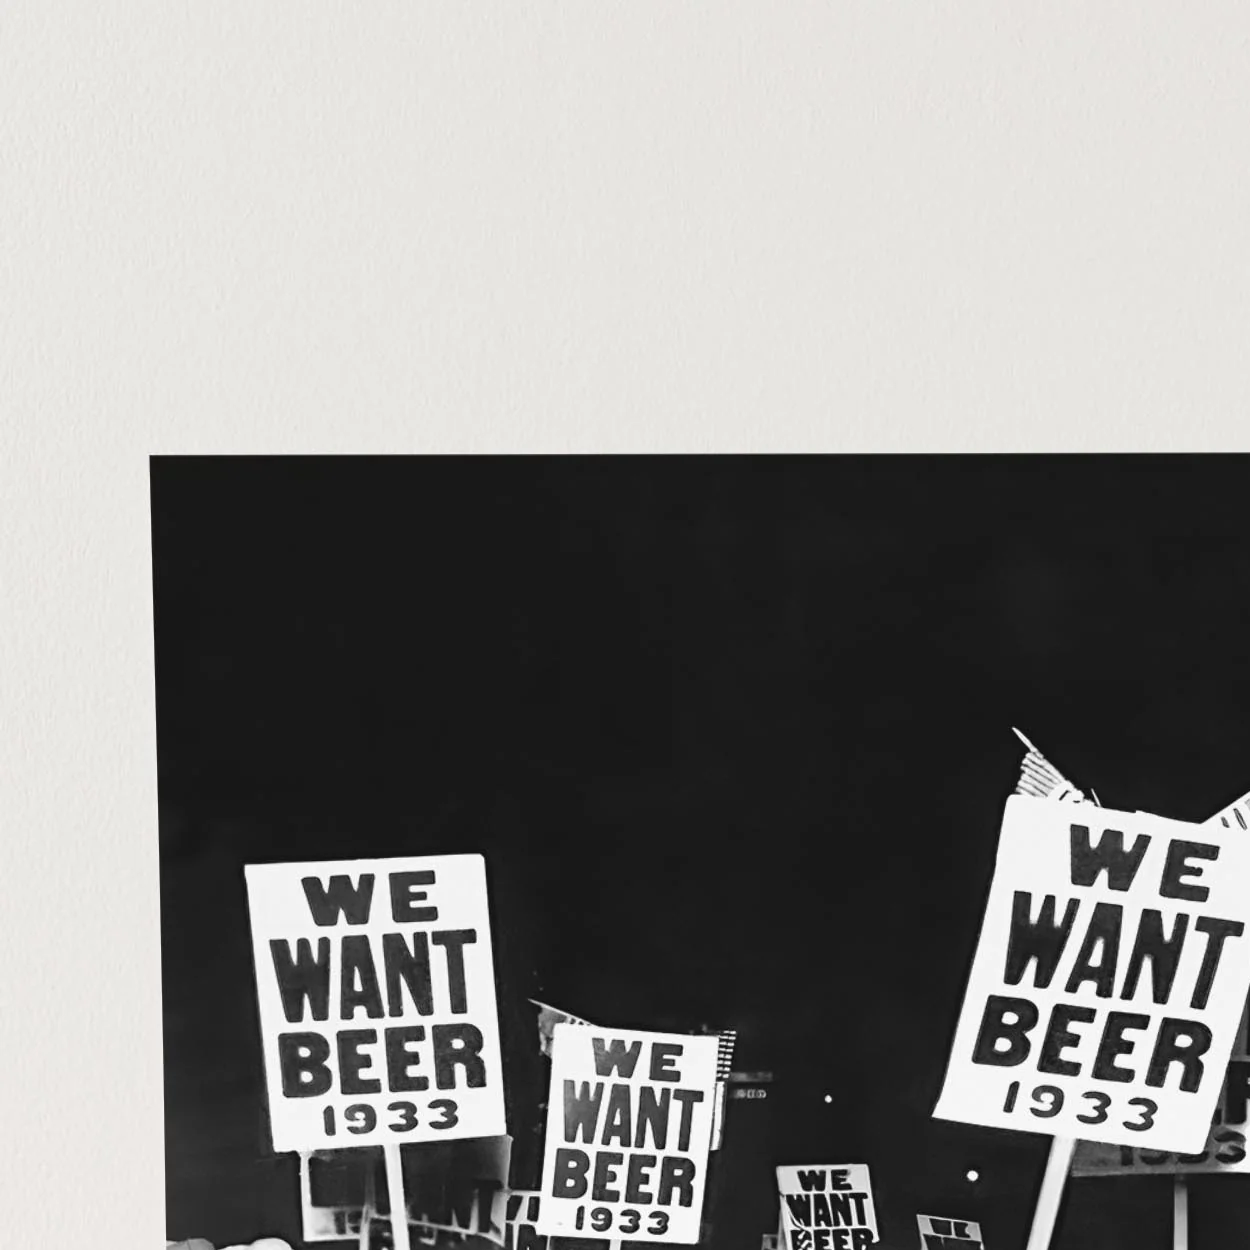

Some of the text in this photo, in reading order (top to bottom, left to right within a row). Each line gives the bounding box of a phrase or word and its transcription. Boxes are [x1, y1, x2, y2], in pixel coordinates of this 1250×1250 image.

[1070, 824, 1220, 902] WE
[301, 870, 438, 926] WE
[270, 929, 476, 1023] WANT
[1004, 891, 1244, 1010] WANT
[278, 1023, 486, 1098] BEER
[592, 1038, 683, 1082] WE
[972, 995, 1212, 1093] BEER
[323, 1099, 458, 1136] 1933
[564, 1080, 704, 1152] WANT
[1003, 1081, 1158, 1131] 1933
[552, 1148, 695, 1207] BEER
[797, 1169, 852, 1192] WE
[576, 1206, 669, 1235] 1933
[786, 1193, 868, 1227] WANT
